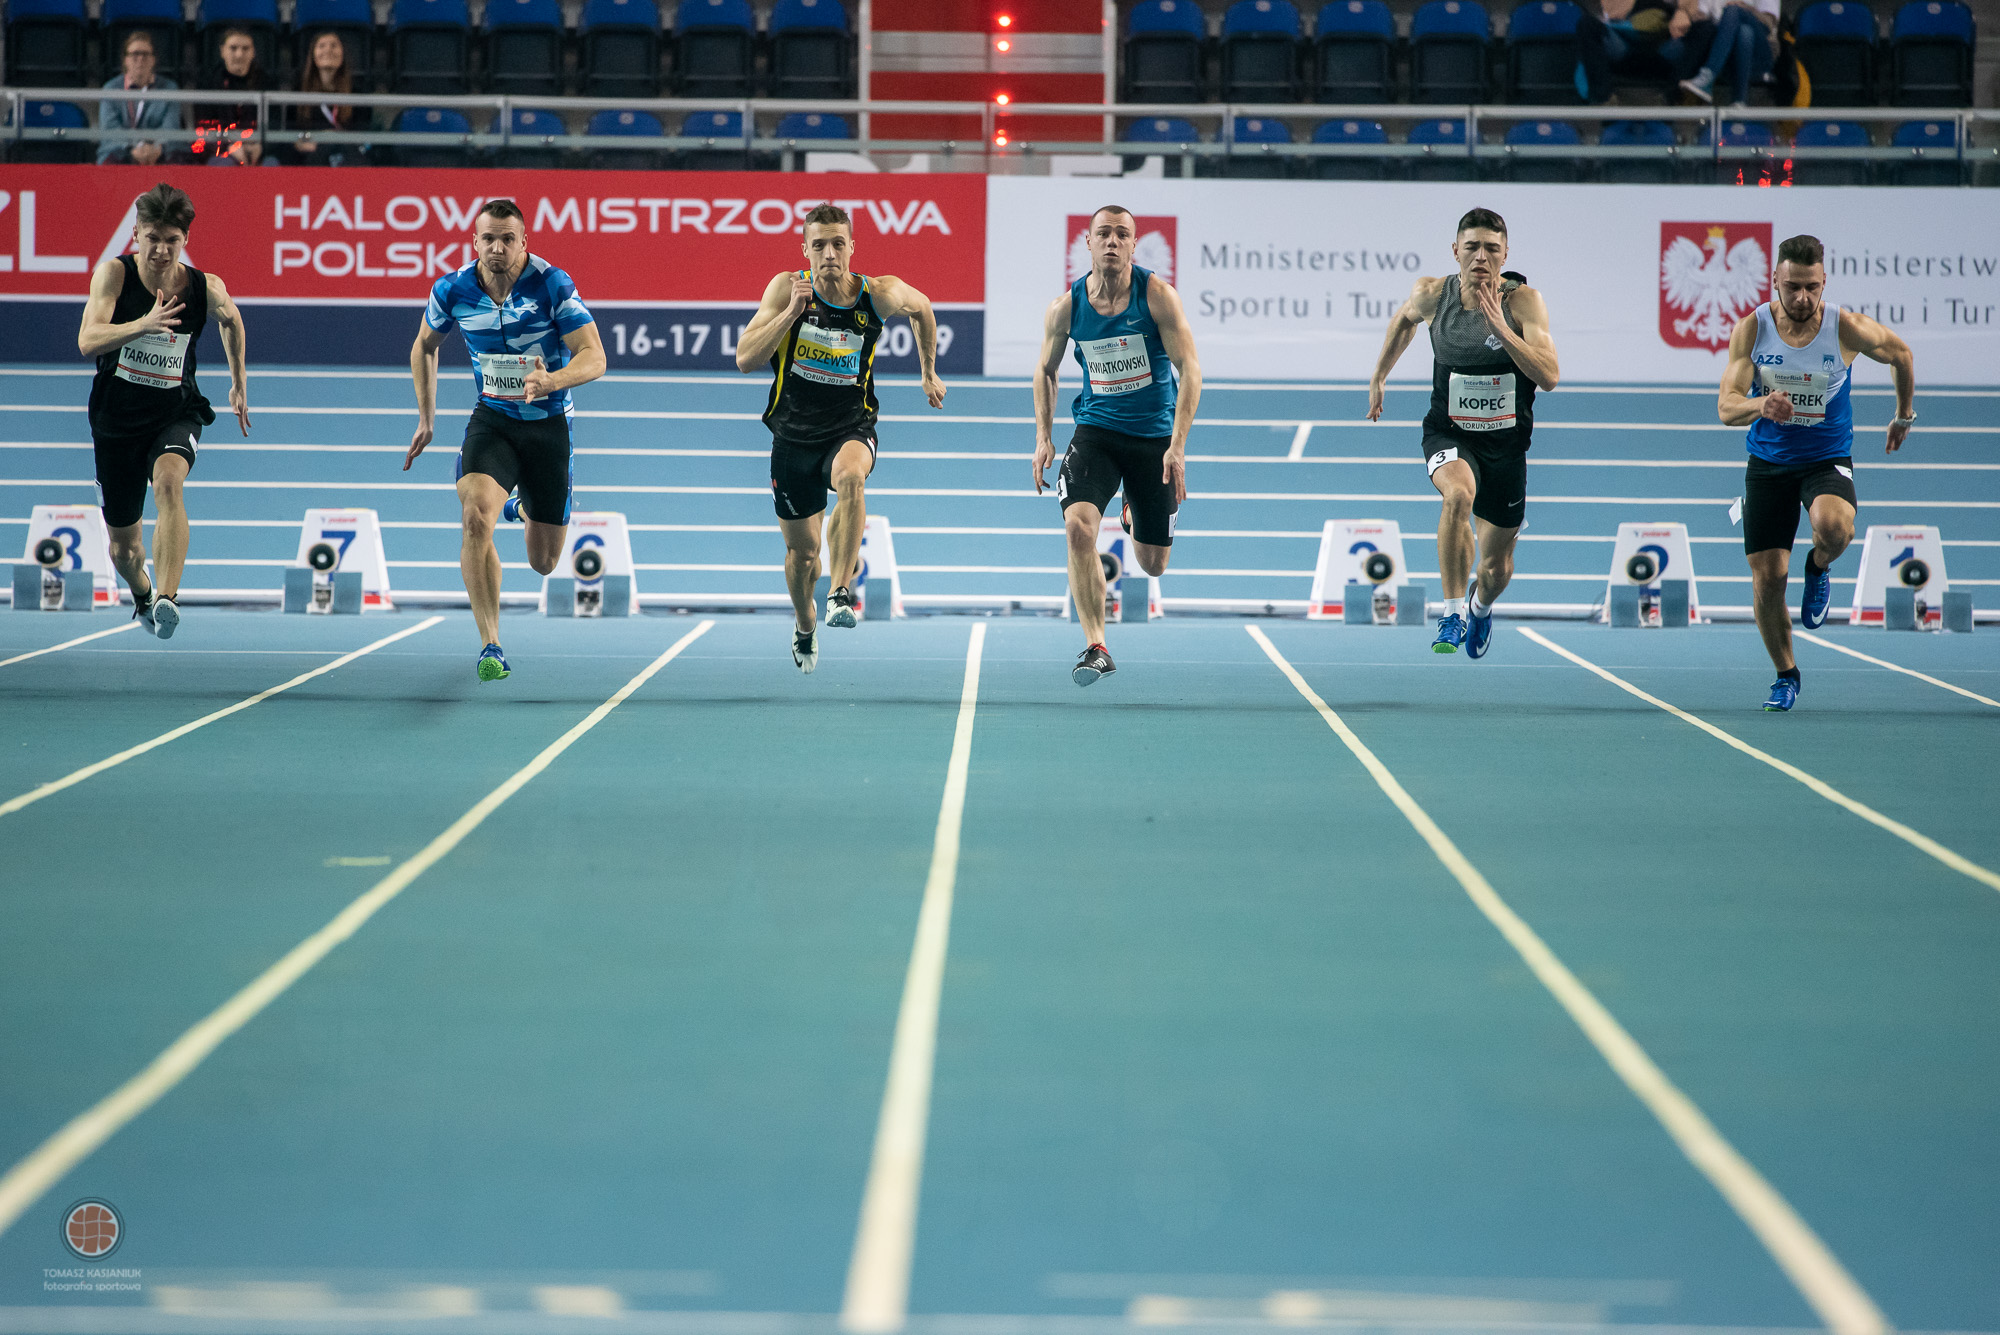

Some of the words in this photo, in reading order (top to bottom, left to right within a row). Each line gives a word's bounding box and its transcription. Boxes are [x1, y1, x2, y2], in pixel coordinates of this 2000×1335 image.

[274, 194, 516, 232] HALOW
[1199, 243, 1422, 273] Ministerstwo
[1830, 249, 1998, 278] inisterstw
[1198, 289, 1309, 323] Sportu
[1325, 291, 1332, 319] i
[1922, 297, 1929, 325] i
[612, 324, 710, 356] 16-17
[874, 324, 955, 356] 209
[1092, 341, 1120, 351] InterRisk
[124, 346, 182, 370] TARKOWSKI
[491, 358, 519, 366] InterRisk
[797, 344, 857, 369] OLSZEWSKI
[1088, 354, 1147, 375] KWIATKOWSKI
[1756, 354, 1784, 365] AZS
[151, 379, 168, 388] 2019
[483, 373, 526, 389] ZIMNIEW
[826, 377, 844, 385] 2019
[1463, 379, 1493, 387] InterRisk
[1774, 373, 1803, 382] InterRisk
[1124, 382, 1140, 391] 2019
[1458, 394, 1506, 411] KOPEĆ
[1486, 421, 1503, 430] 2019
[1793, 416, 1811, 425] 2019
[1434, 450, 1447, 465] 3
[320, 529, 357, 582] 7
